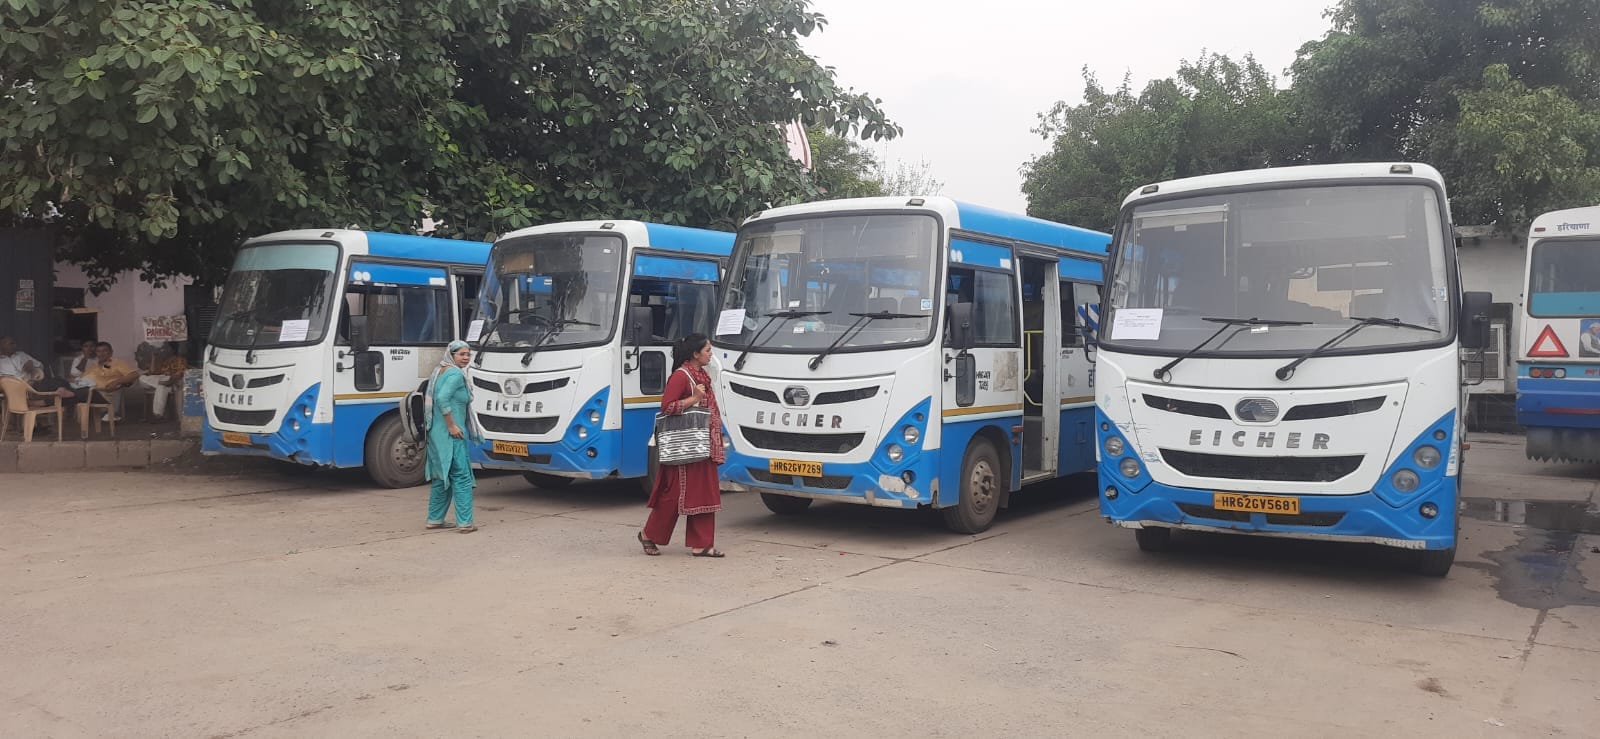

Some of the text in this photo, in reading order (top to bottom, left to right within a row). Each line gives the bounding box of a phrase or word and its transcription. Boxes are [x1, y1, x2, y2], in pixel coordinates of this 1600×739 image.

[486, 399, 544, 413] EICHER
[755, 410, 843, 429] EICHER
[1188, 429, 1330, 450] EICHER
[773, 461, 821, 475] HR62GV7269
[1221, 496, 1297, 512] HR62GV5681
